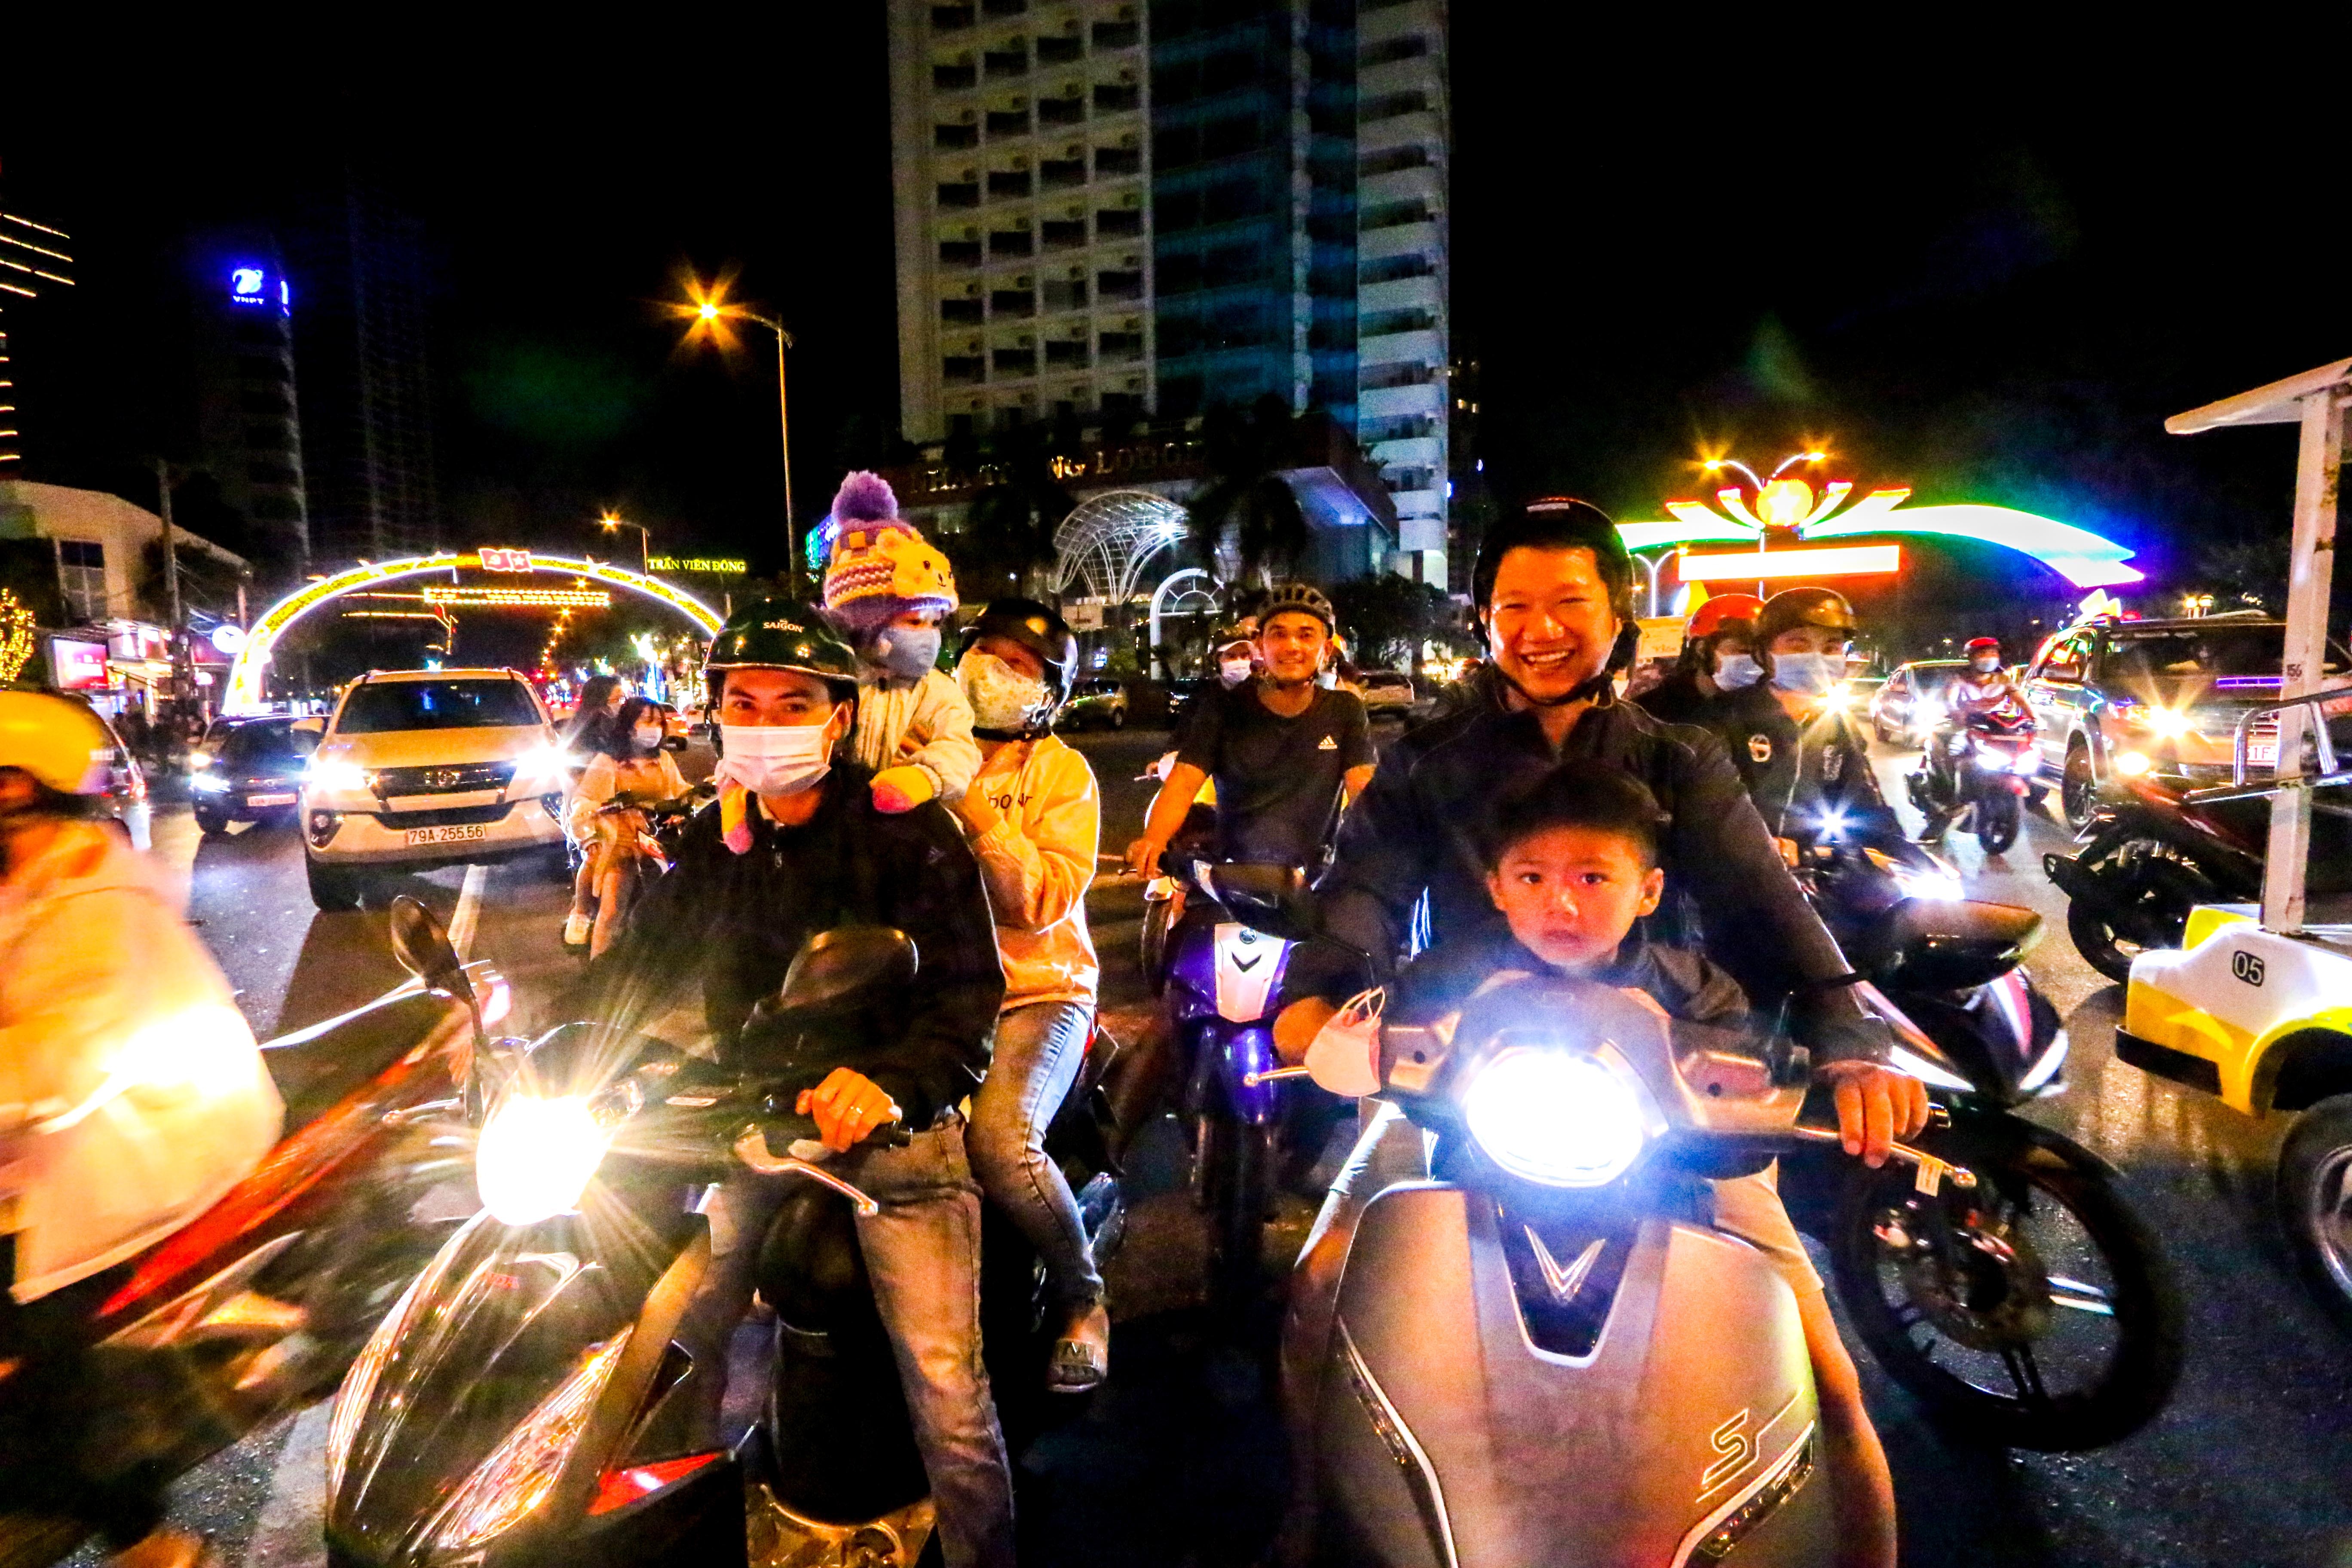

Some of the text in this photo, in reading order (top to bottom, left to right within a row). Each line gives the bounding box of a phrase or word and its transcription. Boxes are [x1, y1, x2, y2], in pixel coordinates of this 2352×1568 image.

[233, 295, 264, 305] VNPT
[763, 622, 803, 633] SAIGON
[409, 825, 484, 843] 79A-255.56
[2234, 951, 2263, 983] 05
